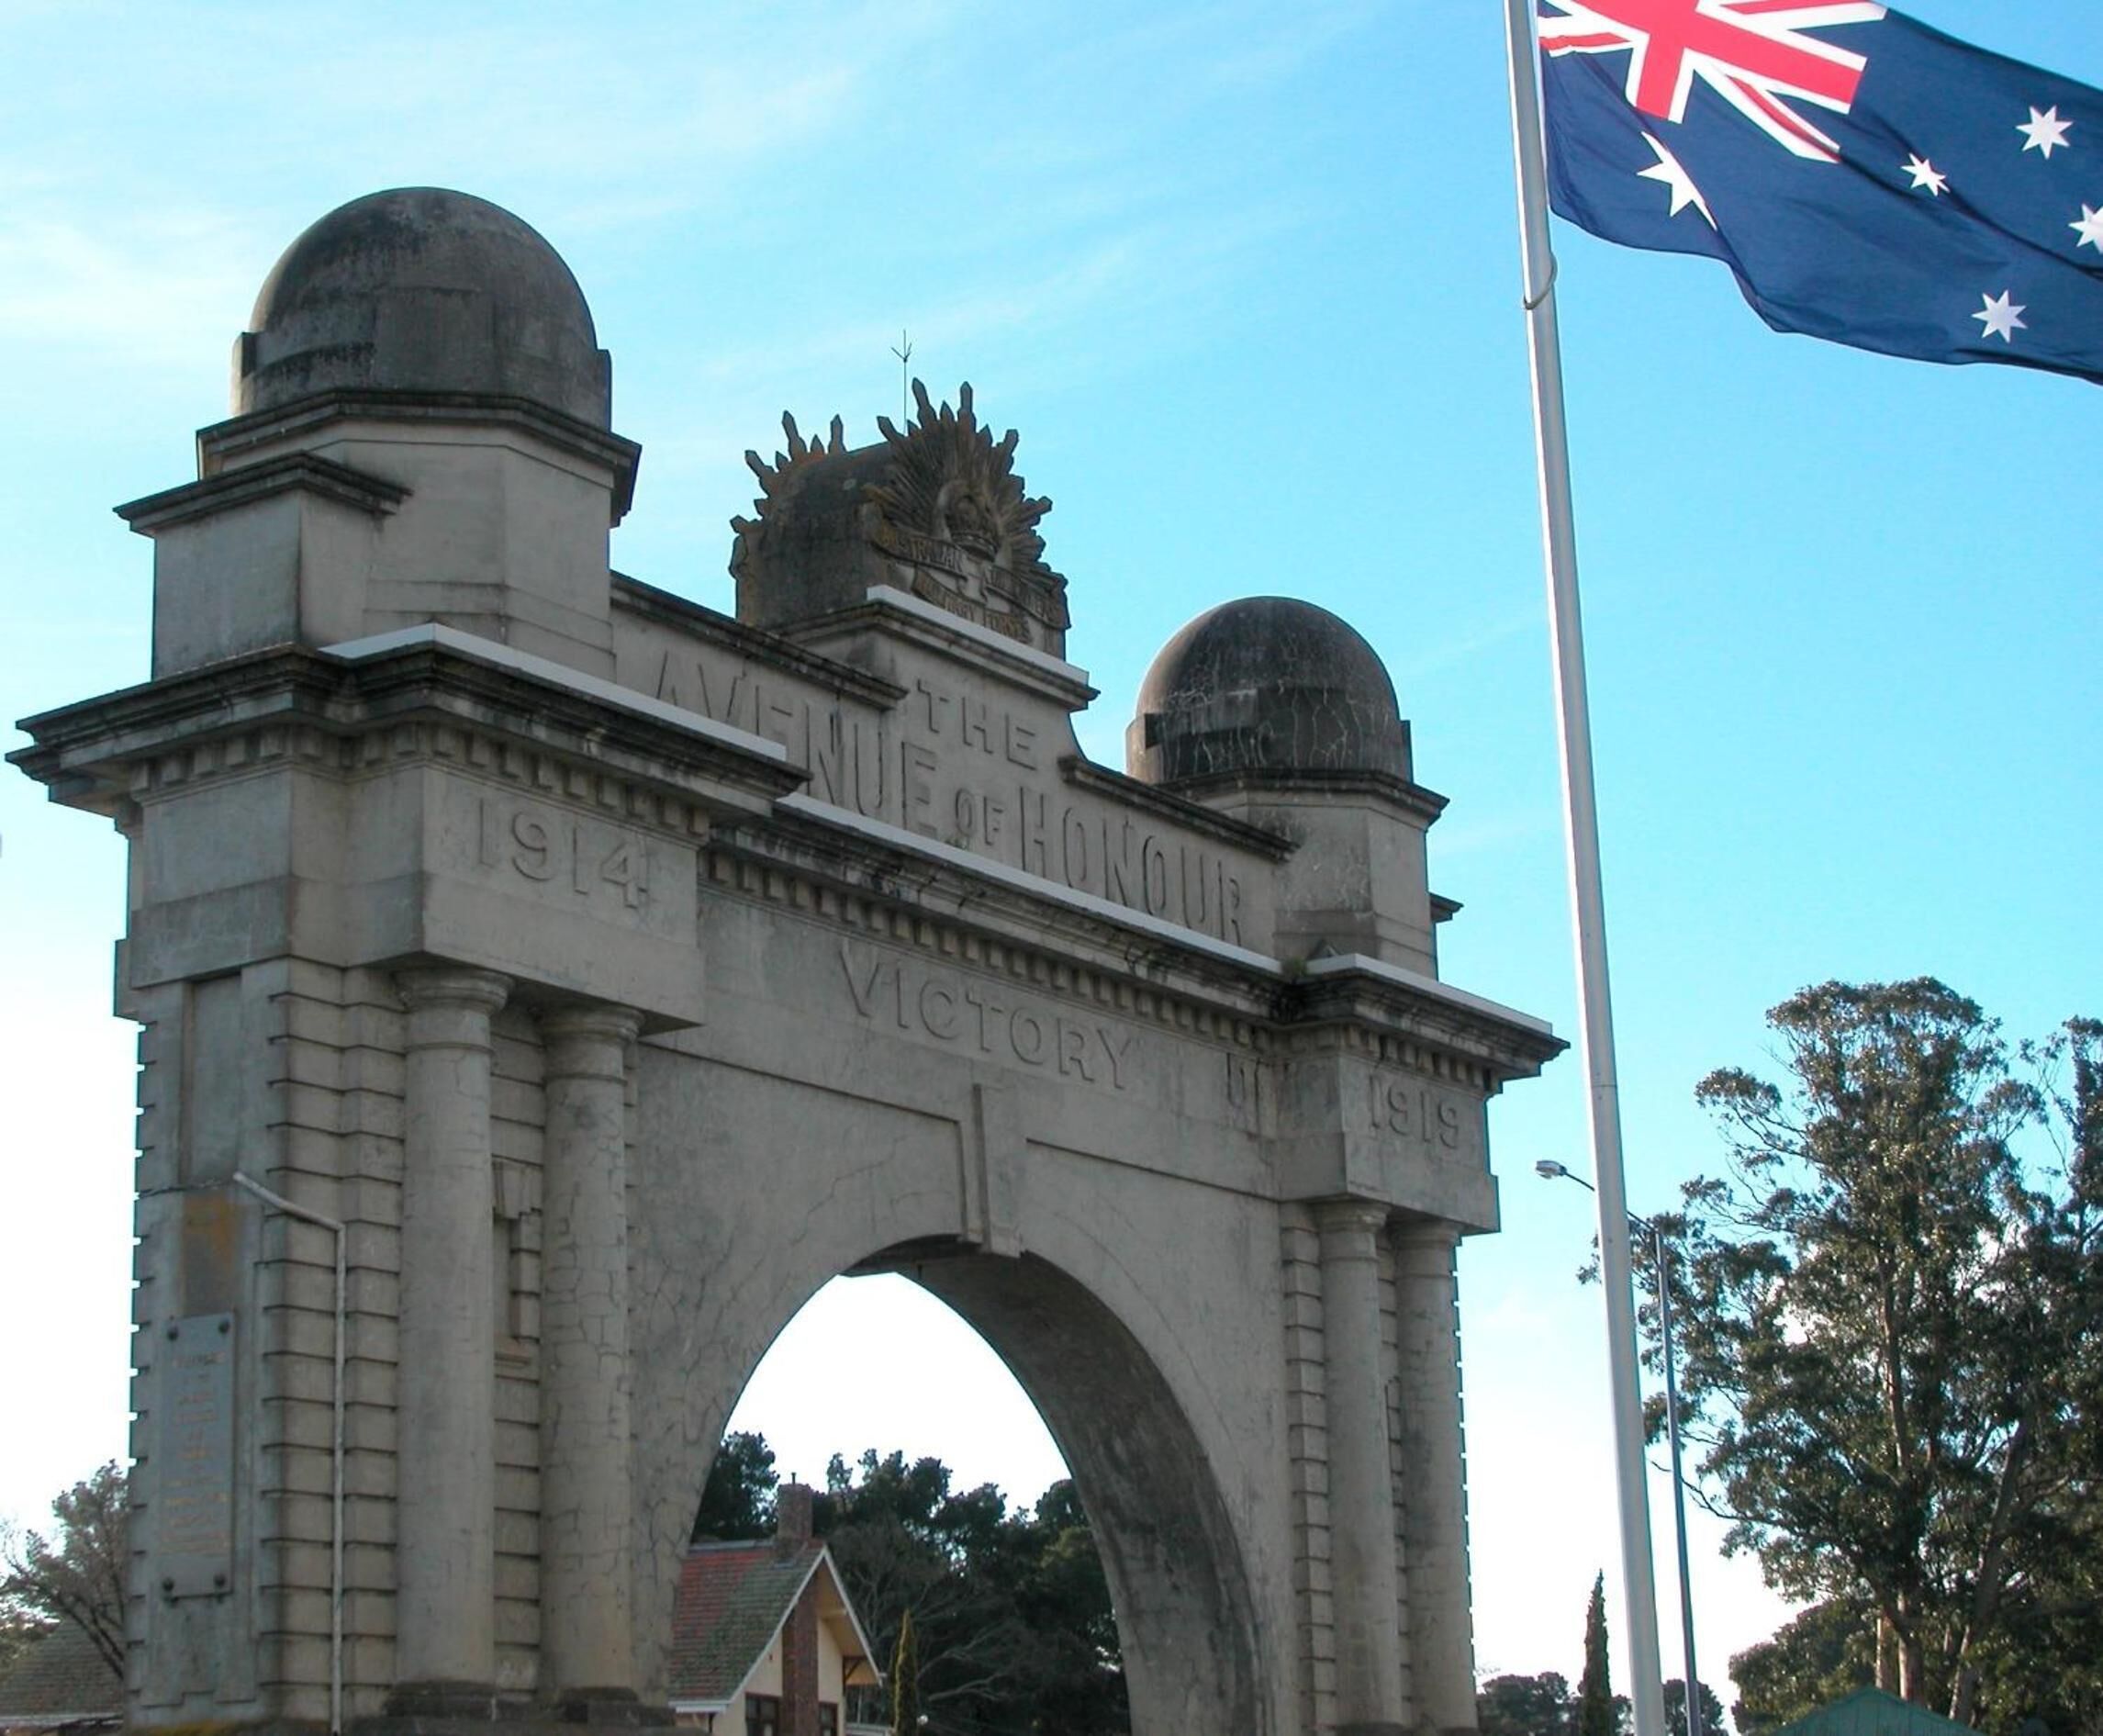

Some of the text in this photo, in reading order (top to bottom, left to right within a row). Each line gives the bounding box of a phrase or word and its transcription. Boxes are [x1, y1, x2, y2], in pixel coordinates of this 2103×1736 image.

[917, 678, 1037, 771] THE
[477, 797, 648, 910] 1914
[655, 648, 1242, 947] AVENUE OF HONOUR
[838, 942, 1132, 1091] VICTORY
[1369, 1073, 1460, 1149] 1919
